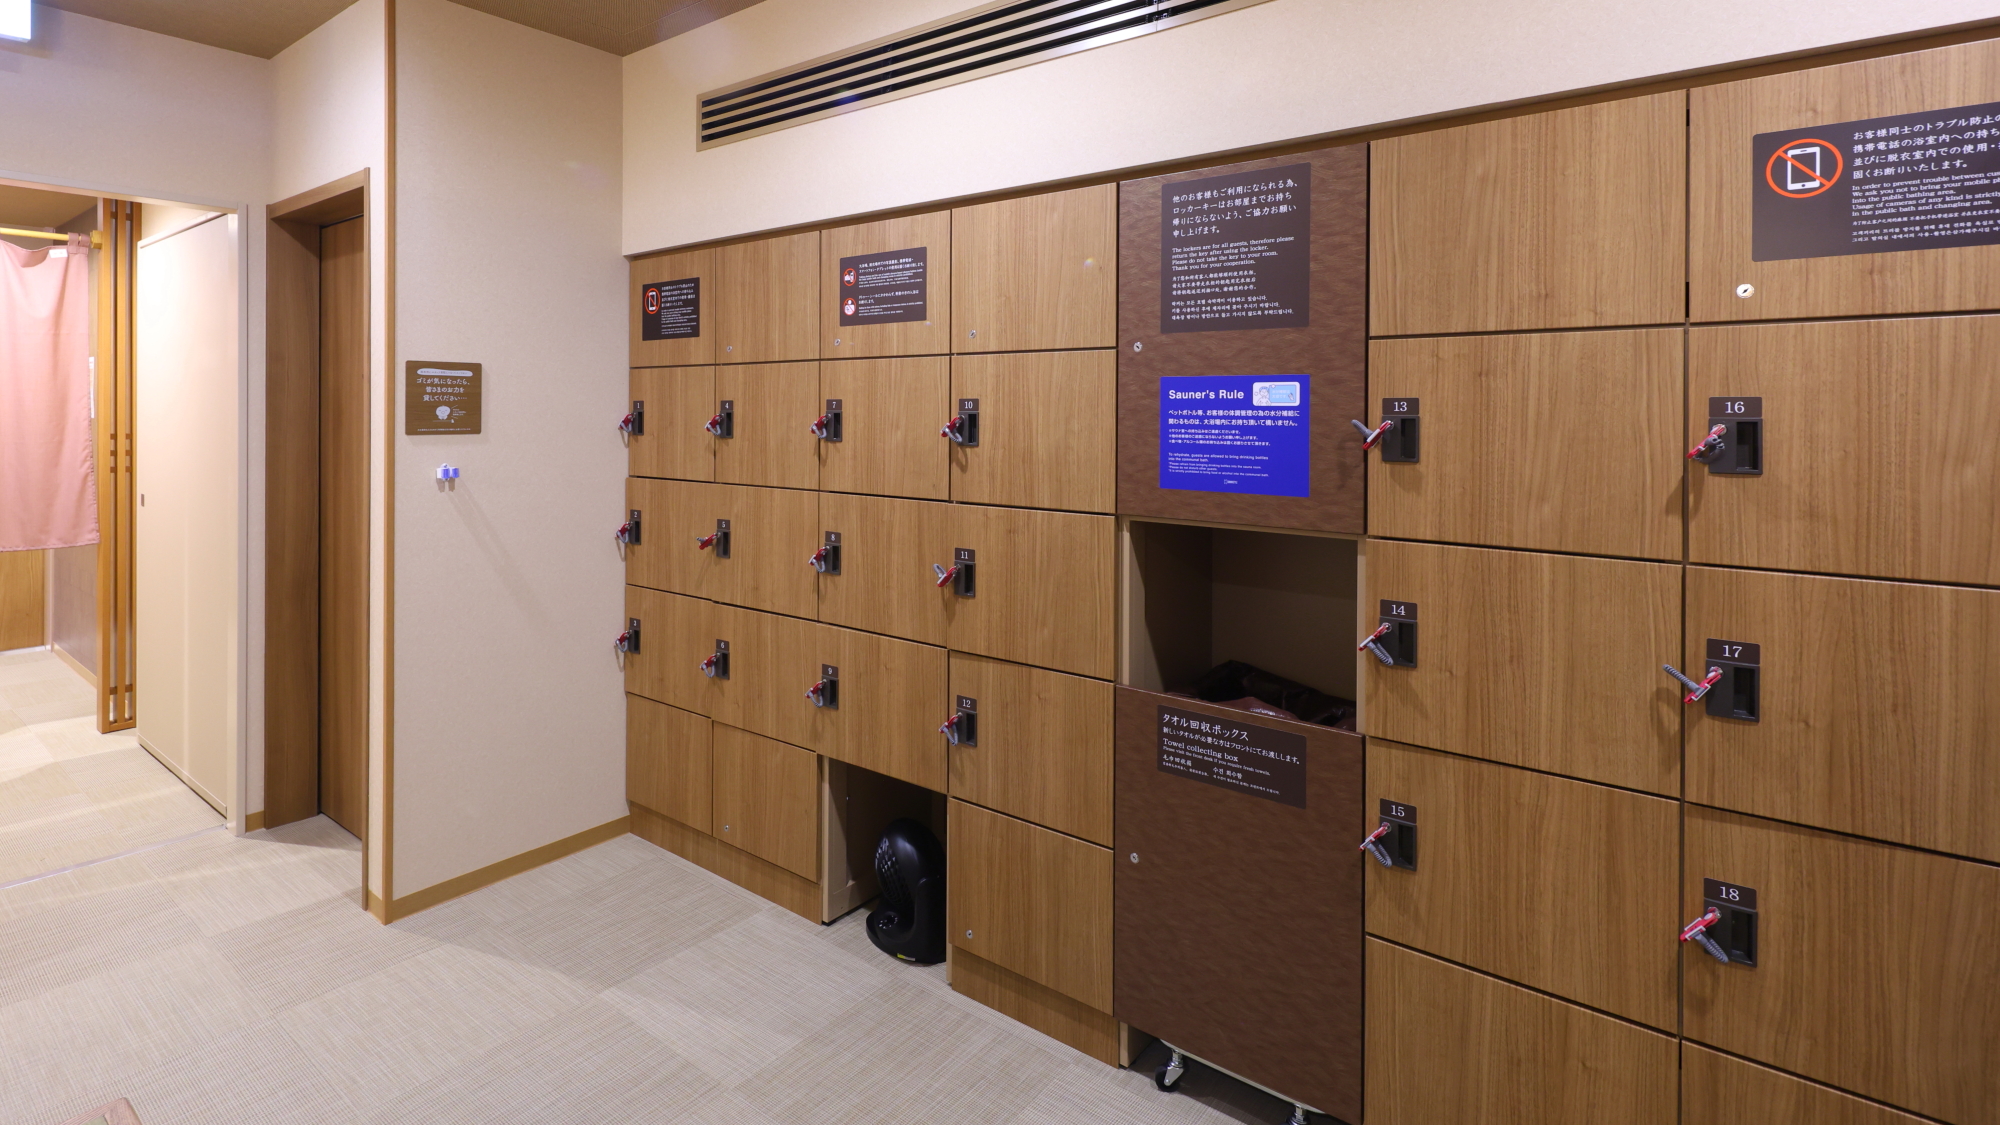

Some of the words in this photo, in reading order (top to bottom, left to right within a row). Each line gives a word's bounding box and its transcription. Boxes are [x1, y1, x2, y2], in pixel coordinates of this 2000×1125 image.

[1853, 142, 2000, 167] 並びに脱衣室内での使用・
[1853, 158, 1968, 180] 固くお断りいたします。
[1892, 180, 1921, 188] prevent
[1952, 172, 1985, 180] between
[1172, 178, 1298, 204] 他のお客様もご利用になられる為、
[1906, 191, 1935, 199] bathing
[1173, 192, 1292, 214] ロッカーキーはお部屋までお持ち
[1875, 207, 1898, 215] public
[1934, 202, 1971, 210] changing
[1172, 204, 1297, 226] 帰りにならないよう、ご協力お願い
[1173, 226, 1220, 238] 申し上げます。
[1250, 238, 1275, 246] therefore
[1168, 390, 1215, 399] Sauner's
[1219, 390, 1244, 399] Rule
[832, 401, 837, 409] 7
[964, 401, 973, 409] 10
[1394, 402, 1407, 411] 13
[1725, 402, 1744, 413] 16
[961, 551, 969, 559] 11
[1392, 605, 1405, 615] 14
[1723, 645, 1742, 658] 17
[963, 699, 971, 707] 12
[1162, 714, 1248, 741] タオル回収ボックス
[1162, 726, 1300, 764] 新しいタオルが必要な方はフロントにてお渡しします。
[1162, 738, 1184, 749] Towel
[1186, 744, 1222, 758] collecting
[1224, 752, 1238, 762] box
[1391, 805, 1405, 817] 15
[1720, 886, 1739, 900] 18
